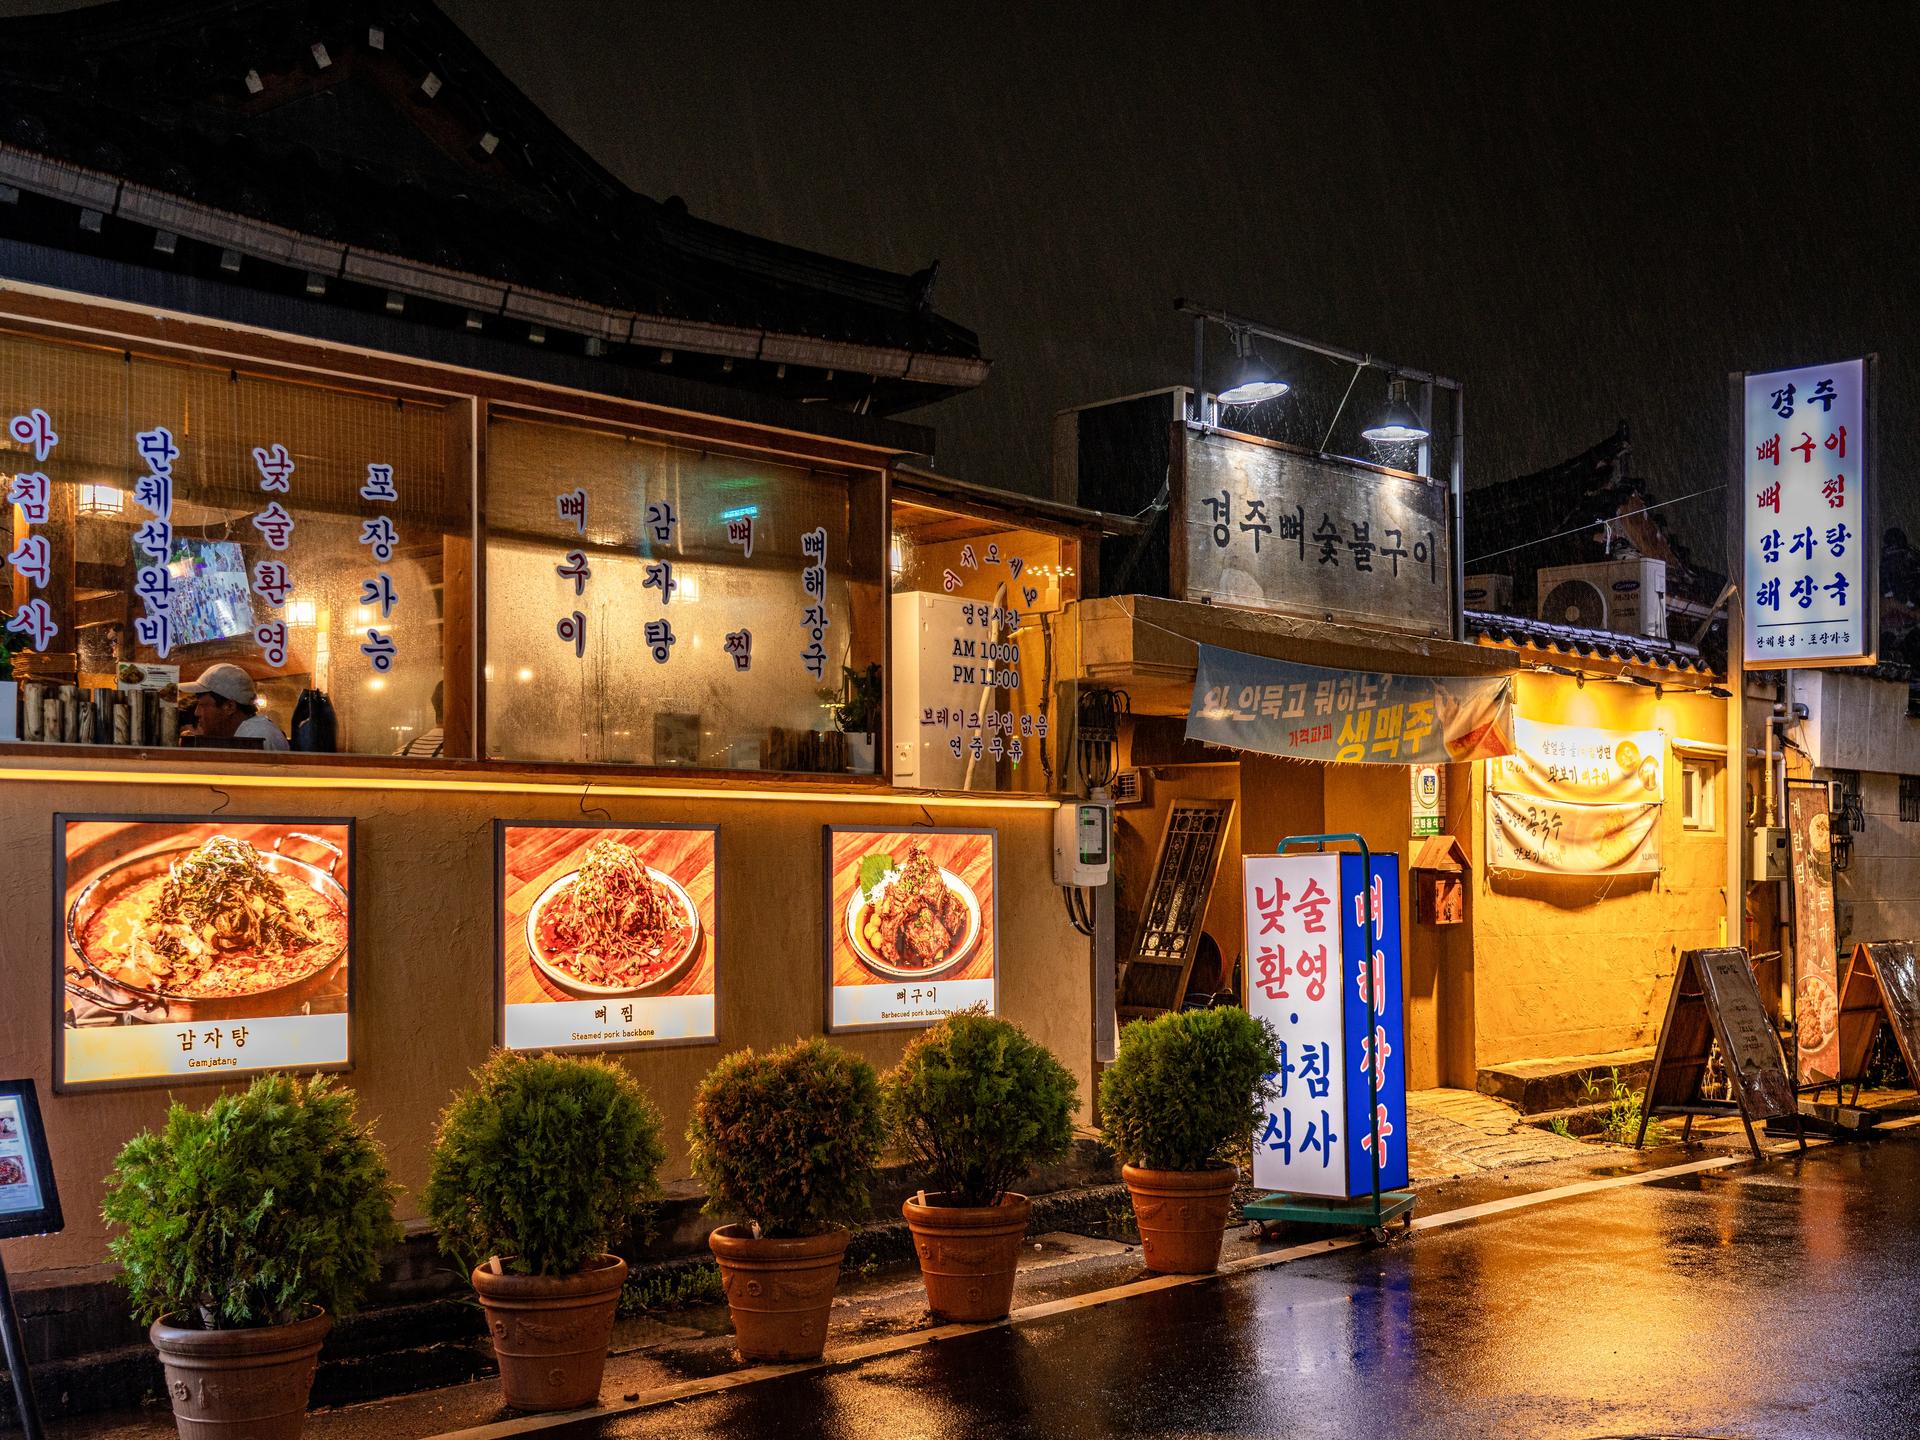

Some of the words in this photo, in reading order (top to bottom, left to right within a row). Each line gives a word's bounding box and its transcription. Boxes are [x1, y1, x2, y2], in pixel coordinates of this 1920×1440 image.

[1771, 379, 1838, 418] 경주
[1756, 425, 1847, 466] 뼈구이
[12, 410, 56, 649] 아침식사
[136, 428, 177, 656] 단체석완비
[1760, 523, 1851, 563] 감자탕
[254, 446, 293, 665] 낮술환영
[362, 465, 396, 671] 포장가능
[557, 489, 589, 657] 뼈구이
[643, 502, 675, 663] 감자탕
[1756, 572, 1849, 611] 해장국
[801, 528, 828, 681] 뼈해장국
[962, 605, 1020, 630] 영업시간
[953, 640, 975, 657] AM
[980, 642, 1019, 662] 10:00
[953, 666, 974, 684] PM
[980, 669, 1019, 688] 11:00
[1020, 715, 1048, 737] 없음
[1288, 722, 1333, 747] 가격파괴
[1336, 700, 1434, 762] 생맥주
[949, 737, 1023, 761] 연중무휴
[1547, 763, 1577, 784] 맛보기
[1254, 876, 1331, 935] 낮술
[1255, 943, 1328, 1002] 환영
[896, 986, 937, 1005] 뼈구이
[911, 1010, 924, 1018] pork
[176, 1026, 249, 1051] 감자탕
[571, 1031, 602, 1041] Steamed
[603, 1031, 620, 1041] pork
[622, 1028, 656, 1038] backbone
[1355, 873, 1393, 1169] 뼈해장국
[188, 1055, 238, 1068] Gamjatang
[1260, 1106, 1338, 1169] 식사
